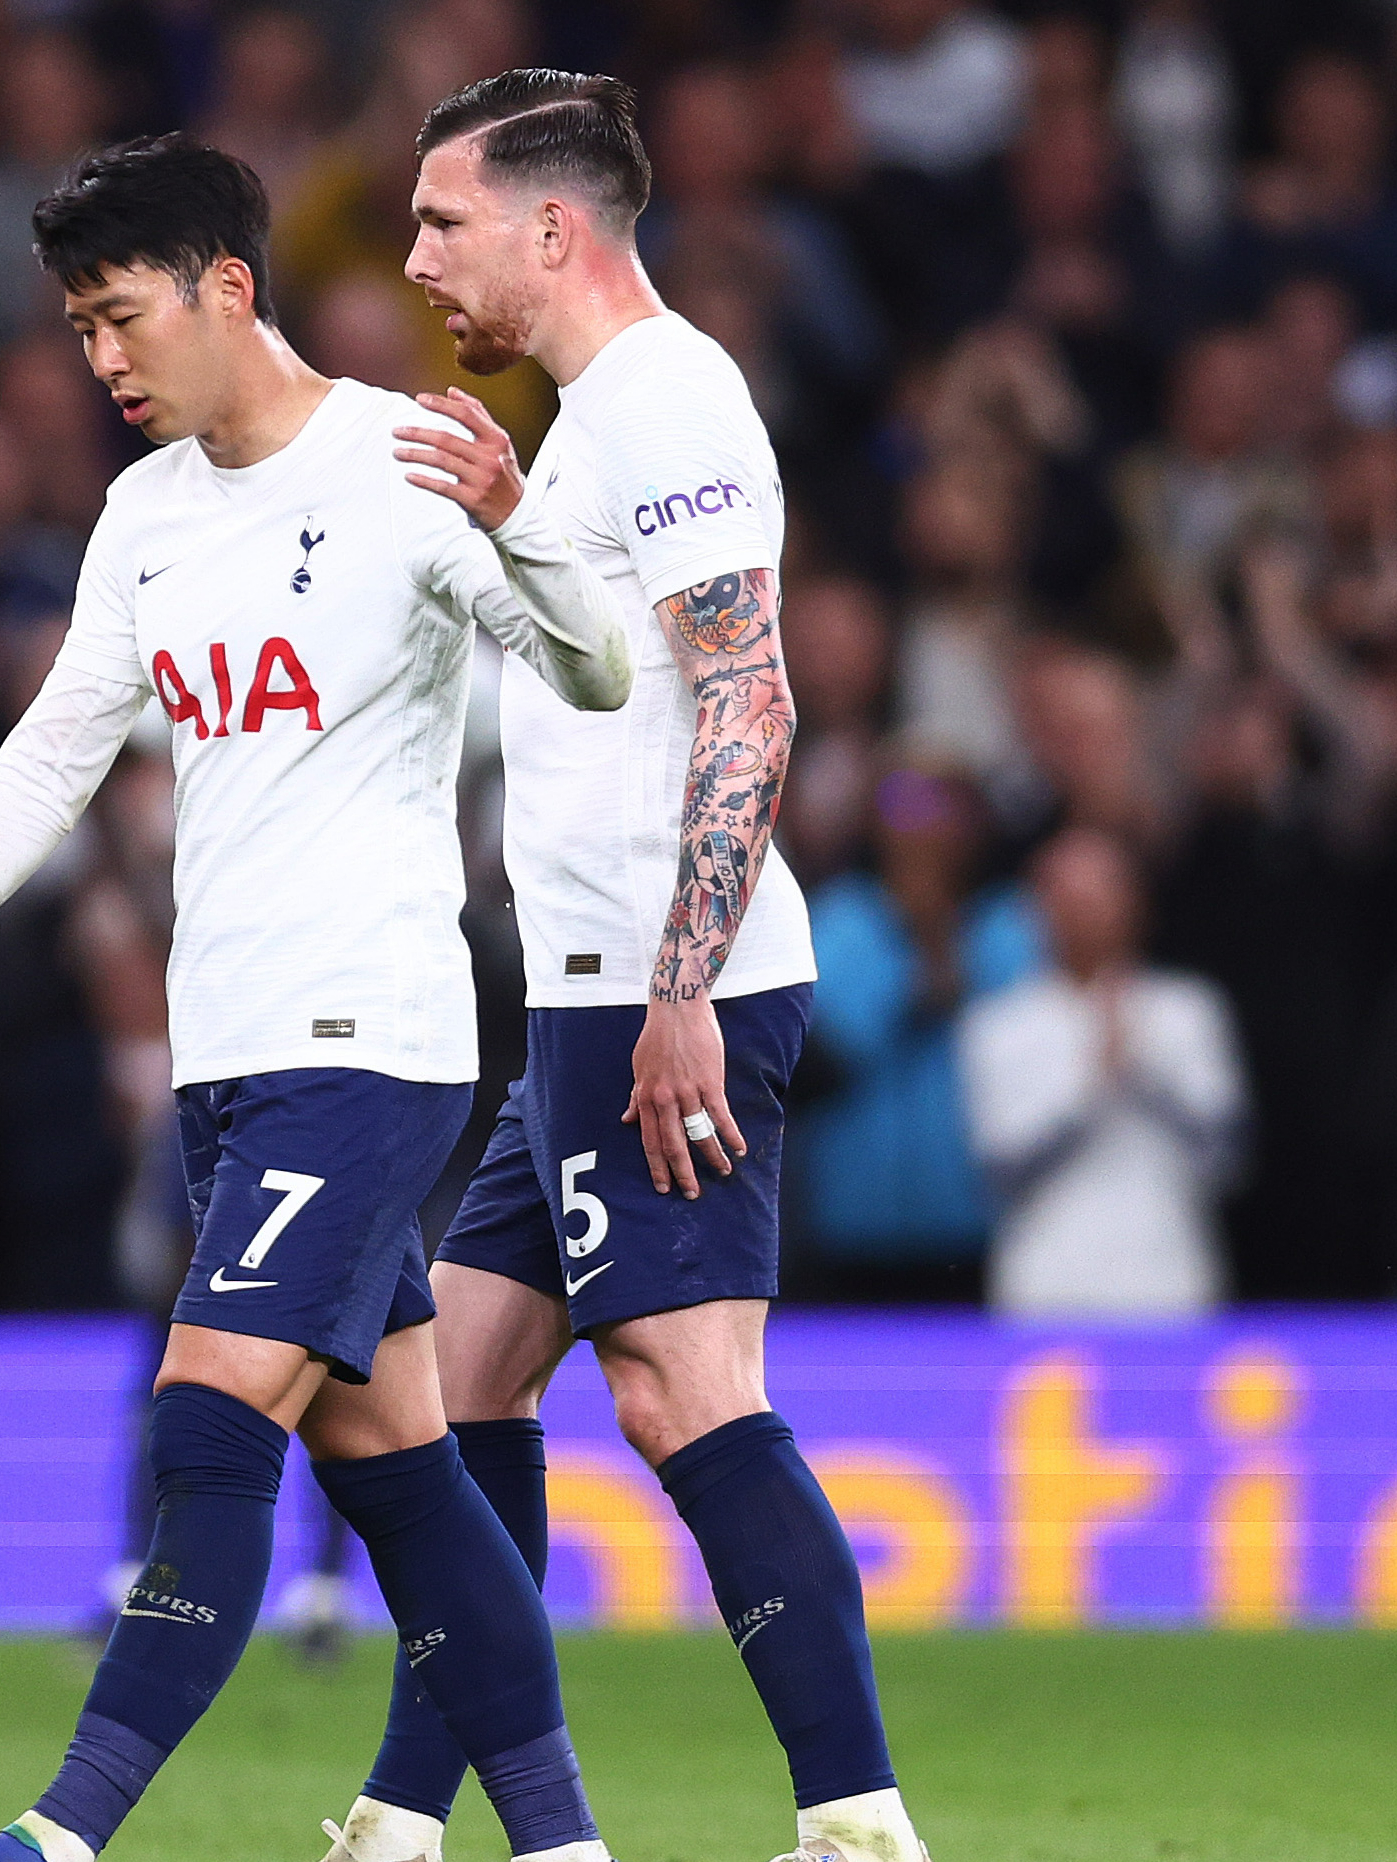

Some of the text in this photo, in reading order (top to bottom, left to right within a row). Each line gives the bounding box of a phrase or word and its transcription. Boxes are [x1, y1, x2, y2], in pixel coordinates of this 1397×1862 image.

[635, 478, 752, 537] cinch
[152, 636, 325, 741] AIA
[238, 1168, 327, 1270] 7
[561, 1150, 609, 1259] 5
